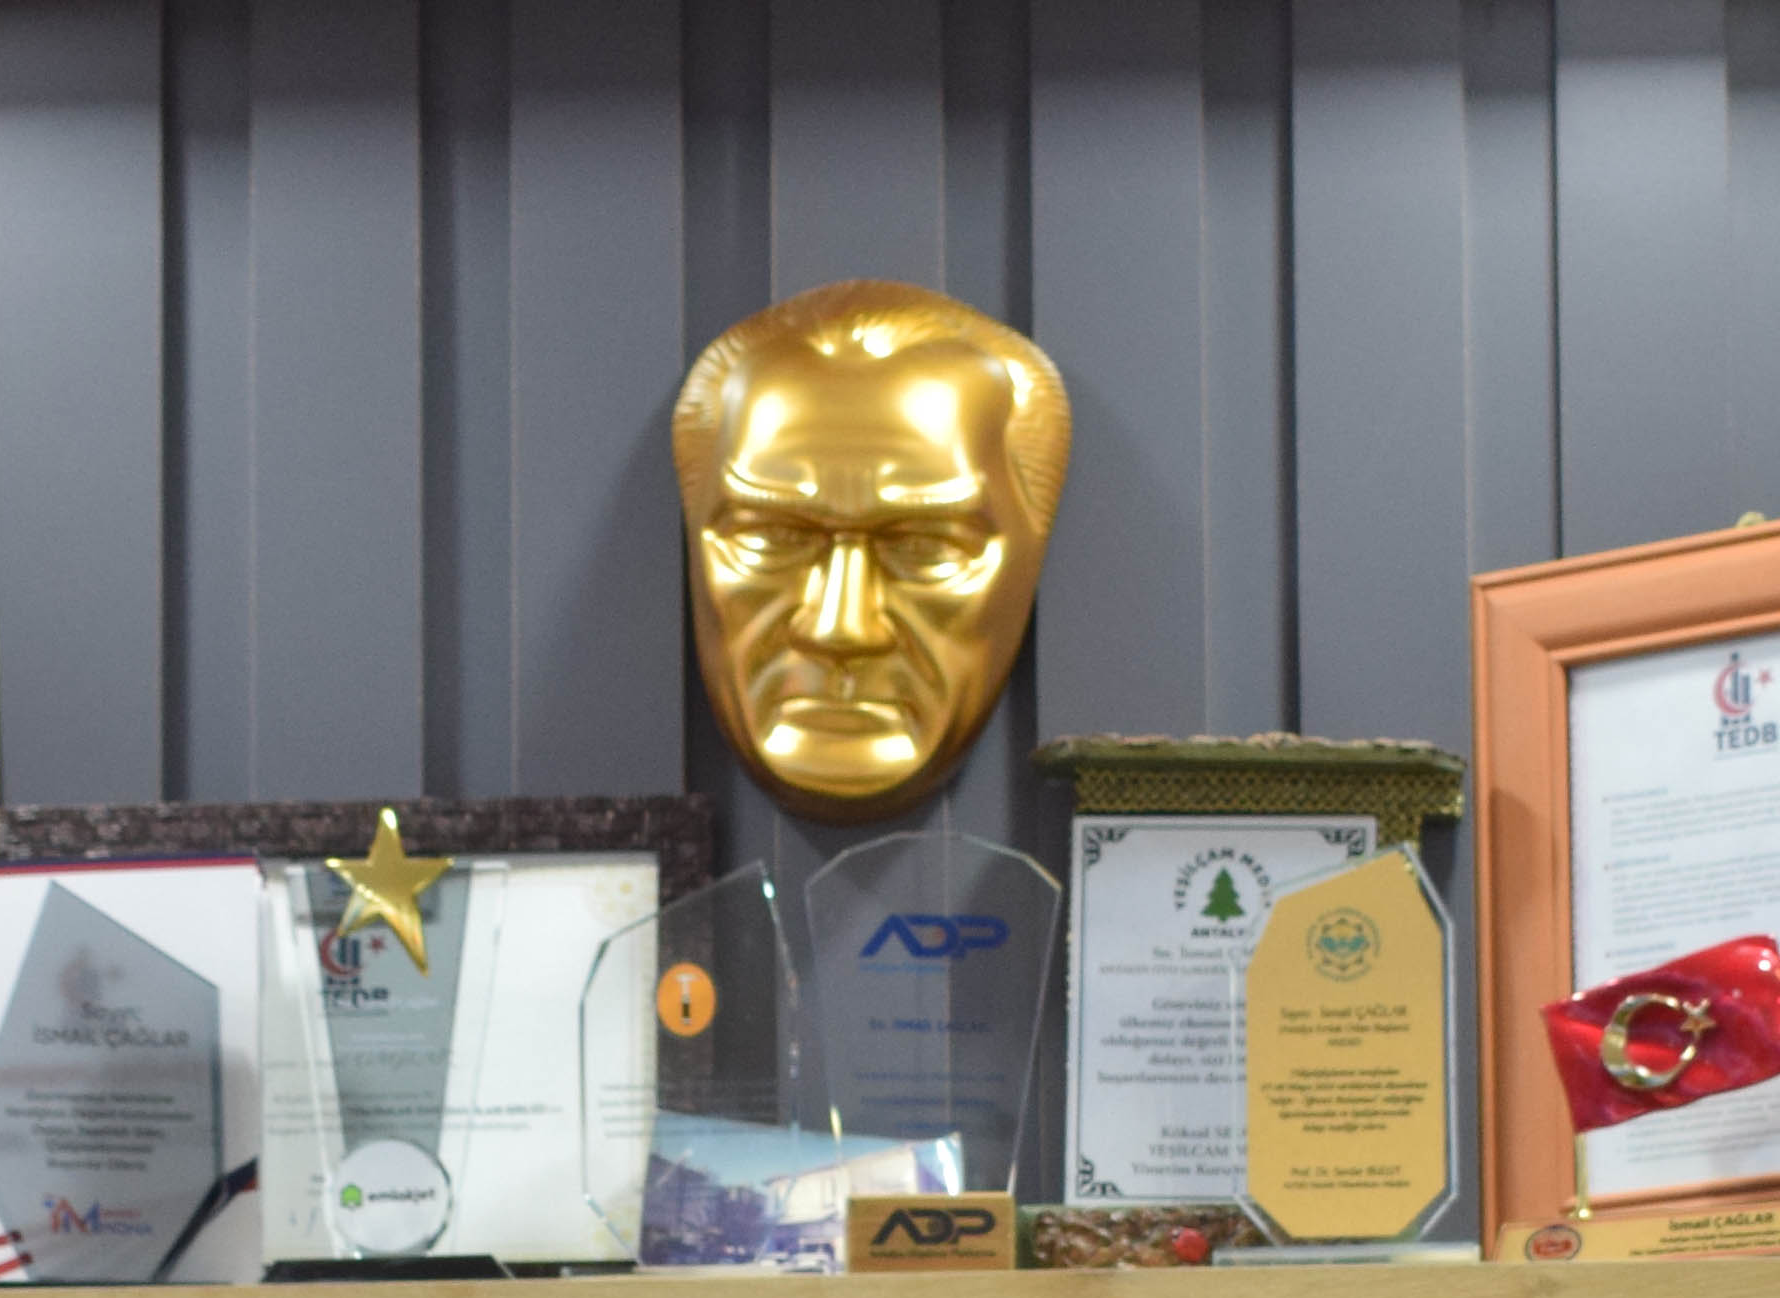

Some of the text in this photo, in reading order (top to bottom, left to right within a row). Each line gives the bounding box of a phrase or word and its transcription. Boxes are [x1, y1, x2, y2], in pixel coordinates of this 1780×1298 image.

[1713, 722, 1780, 751] TEDB
[1191, 928, 1248, 938] ANTALY
[869, 1208, 997, 1246] ADP
